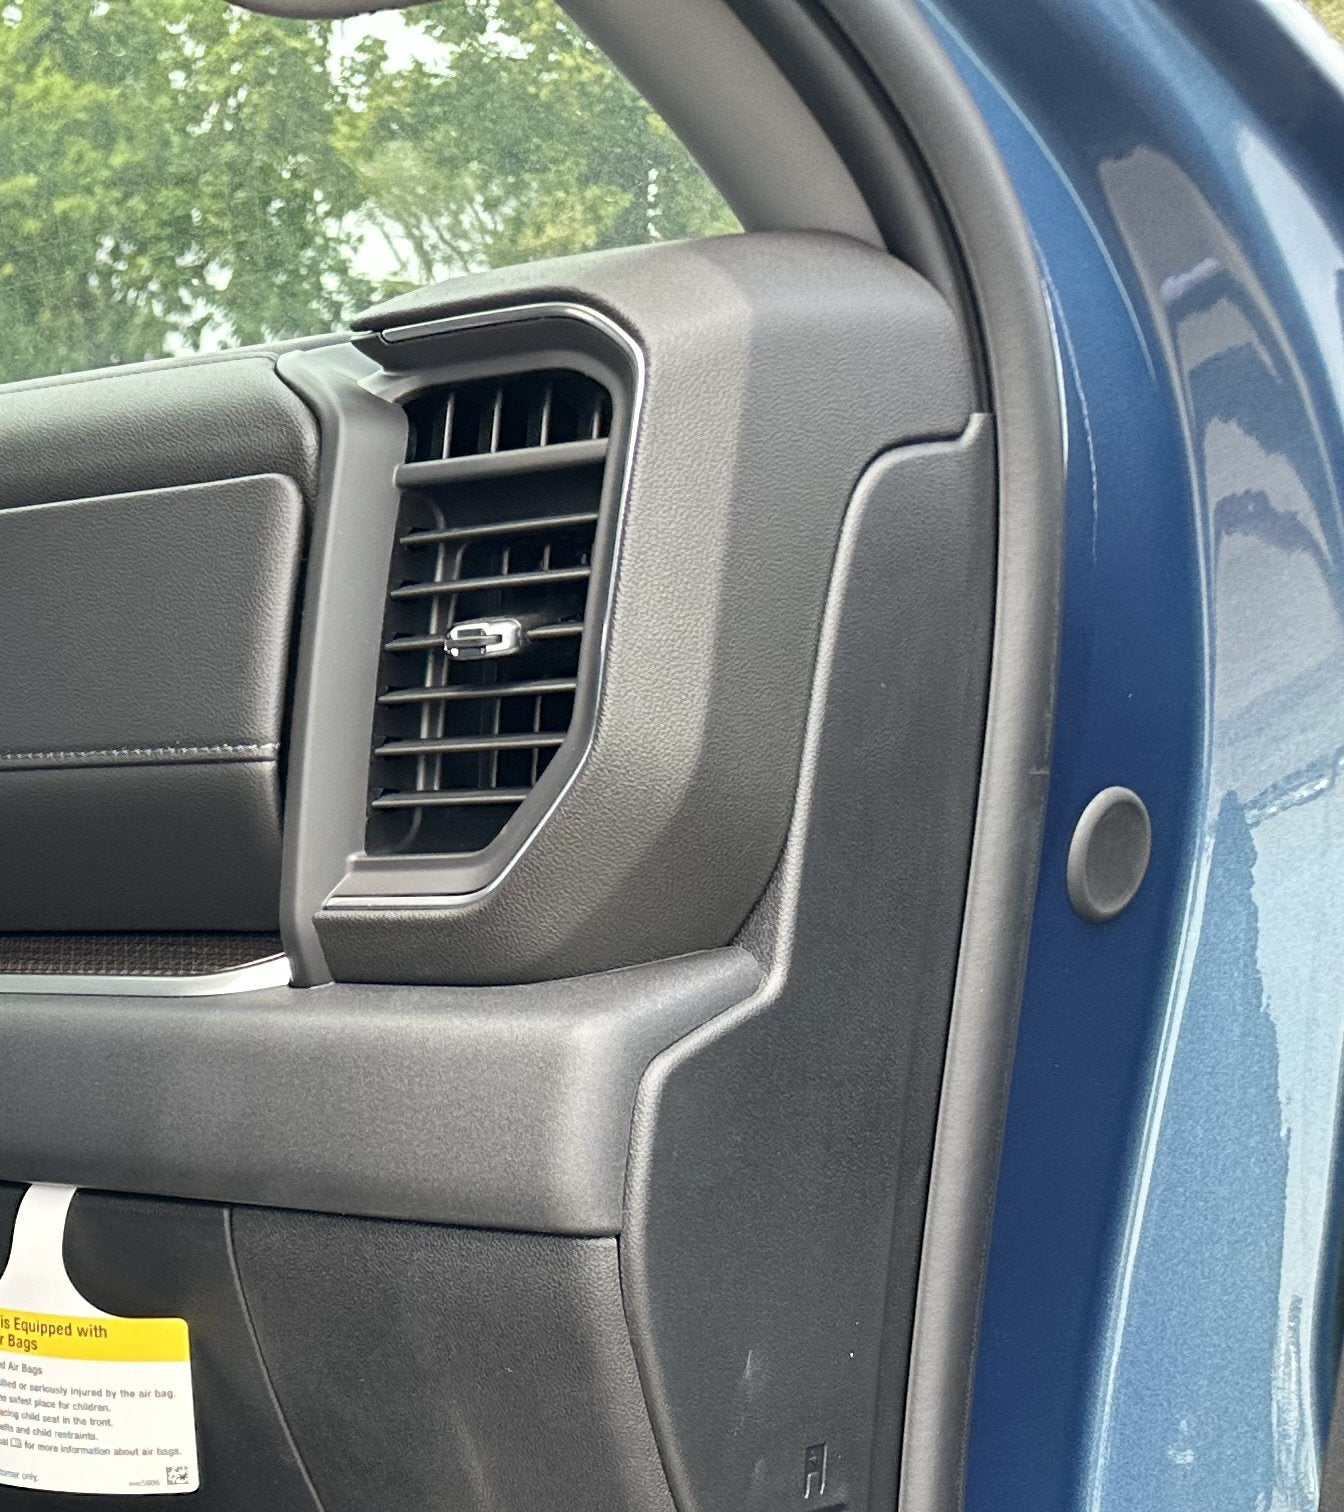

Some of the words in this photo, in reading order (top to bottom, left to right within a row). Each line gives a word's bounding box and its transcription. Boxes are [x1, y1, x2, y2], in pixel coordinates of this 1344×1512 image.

[0, 1314, 10, 1329] is
[14, 1317, 72, 1337] Equipped
[77, 1324, 107, 1338] with
[8, 1334, 38, 1352] Bags
[8, 1362, 19, 1371] Air
[22, 1364, 42, 1376] Bags
[30, 1384, 67, 1396] seriously
[71, 1388, 102, 1398] injured
[106, 1389, 116, 1398] by
[120, 1389, 135, 1398] the
[139, 1389, 151, 1398] air
[155, 1389, 175, 1399] bag.
[9, 1396, 32, 1405] safest
[34, 1399, 56, 1408] place
[59, 1401, 70, 1410] for
[73, 1402, 111, 1412] children.
[21, 1411, 40, 1421] child
[42, 1415, 60, 1423] seat
[63, 1416, 70, 1424] in
[73, 1417, 86, 1425] the
[90, 1418, 113, 1426] front.
[16, 1426, 30, 1434] and
[32, 1428, 52, 1437] child
[55, 1431, 98, 1440] restraints.
[25, 1440, 34, 1449] for
[38, 1444, 58, 1452] more
[61, 1444, 110, 1455] information
[114, 1447, 139, 1456] about
